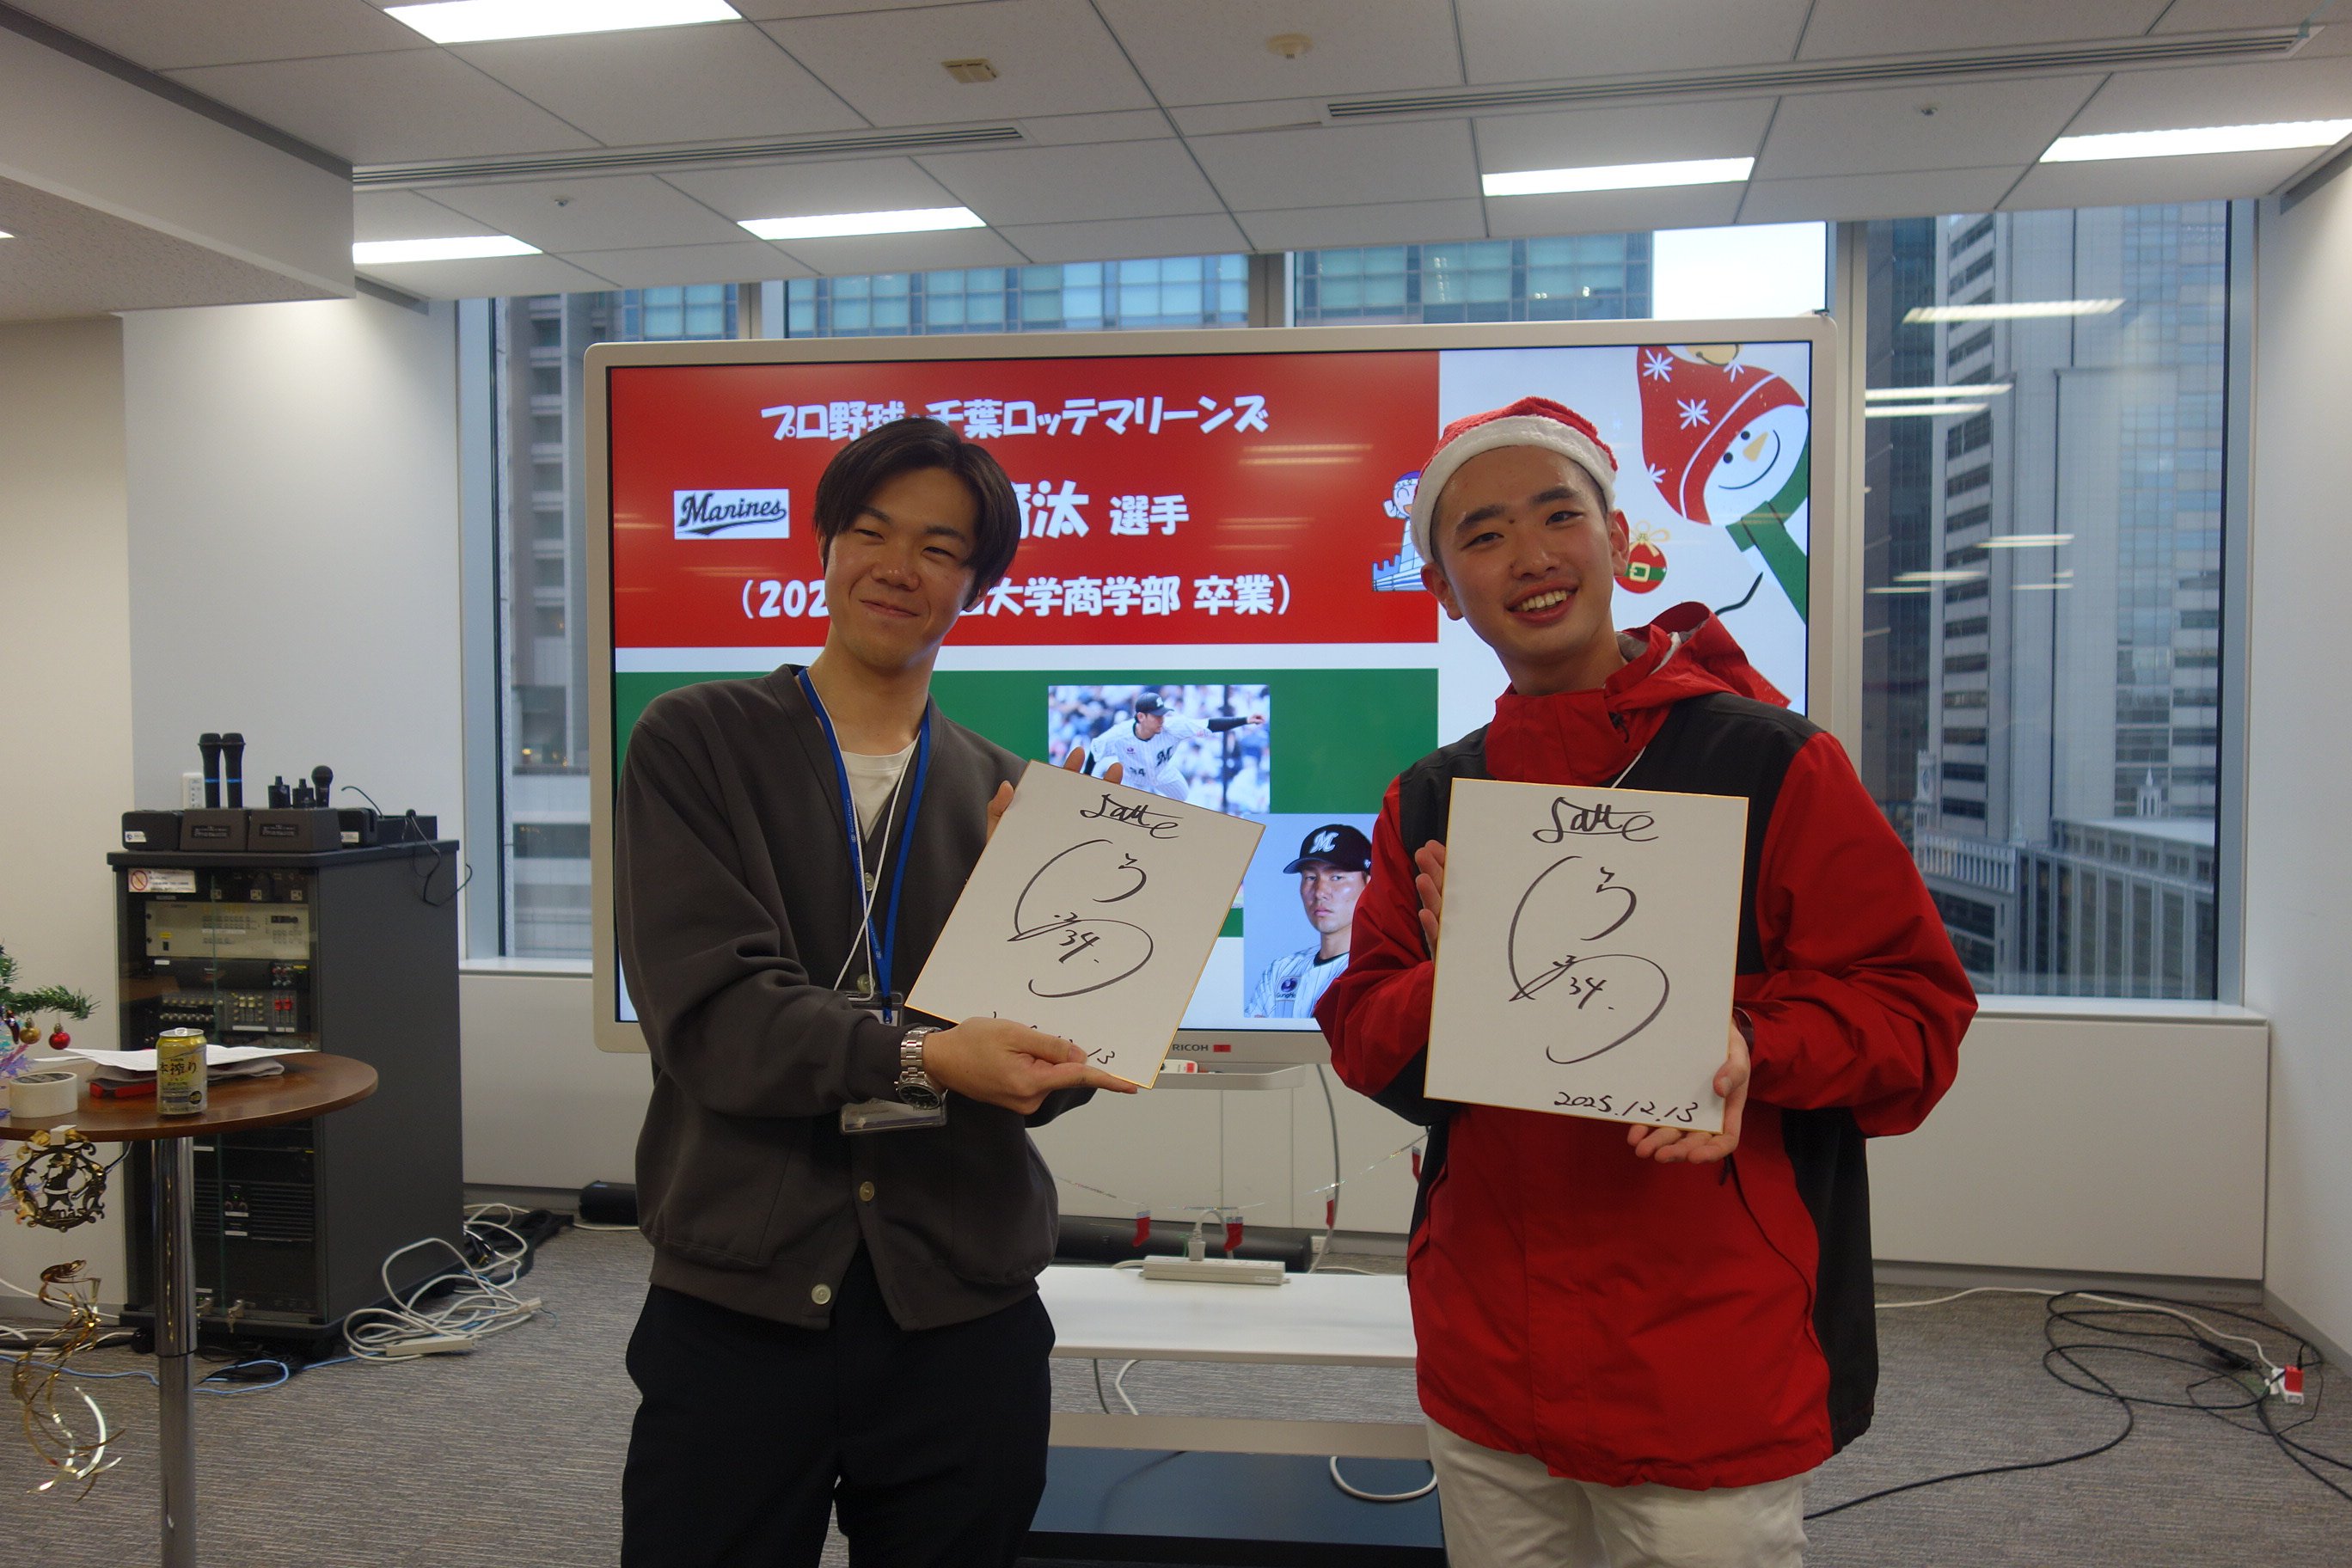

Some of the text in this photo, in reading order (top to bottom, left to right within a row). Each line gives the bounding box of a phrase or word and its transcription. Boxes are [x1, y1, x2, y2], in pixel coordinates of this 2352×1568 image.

[677, 492, 787, 527] Marines
[1109, 494, 1190, 536] 選手
[959, 575, 1181, 617] 大学商学部
[1193, 574, 1290, 616] 卒業)
[1172, 1044, 1209, 1052] RICOH
